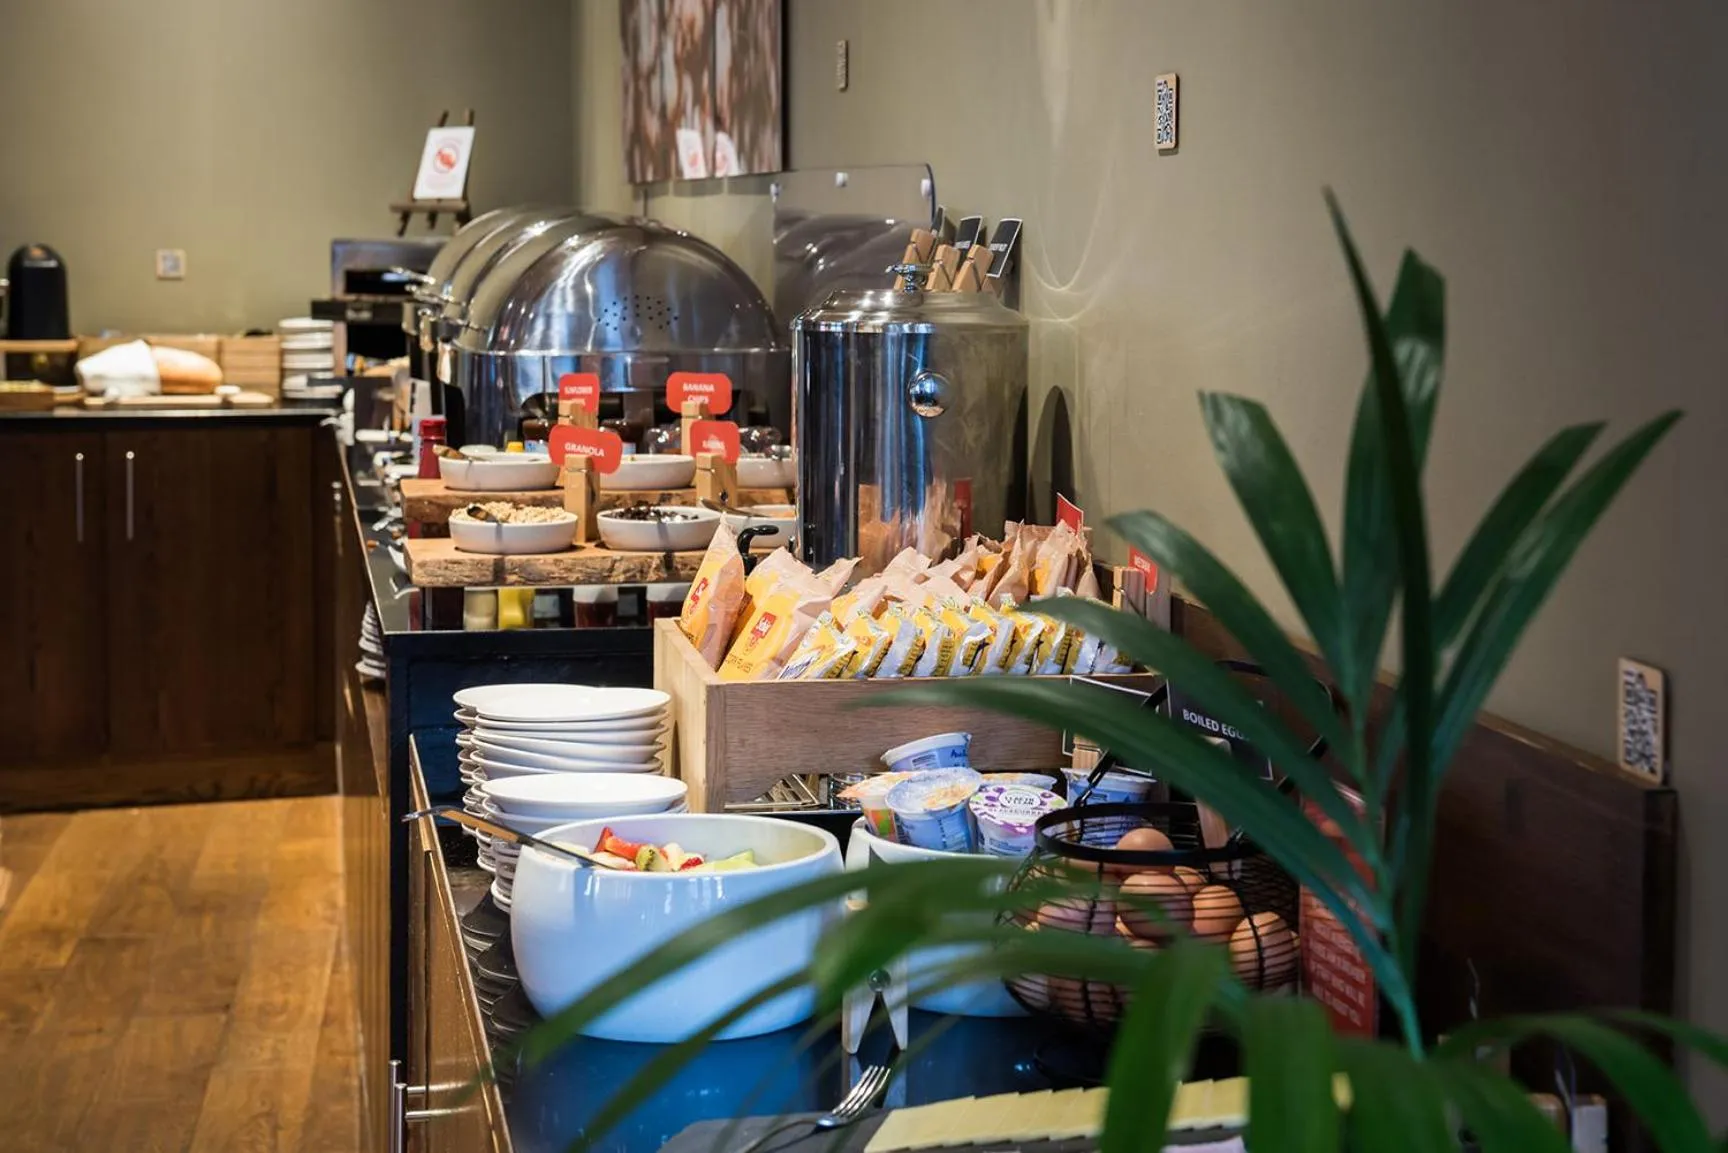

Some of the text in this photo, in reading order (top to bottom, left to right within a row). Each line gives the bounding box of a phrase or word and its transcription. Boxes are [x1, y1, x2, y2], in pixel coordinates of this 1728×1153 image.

[683, 383, 715, 392] BANANA
[564, 442, 605, 457] GRANOLA
[1182, 709, 1219, 733] BOILED
